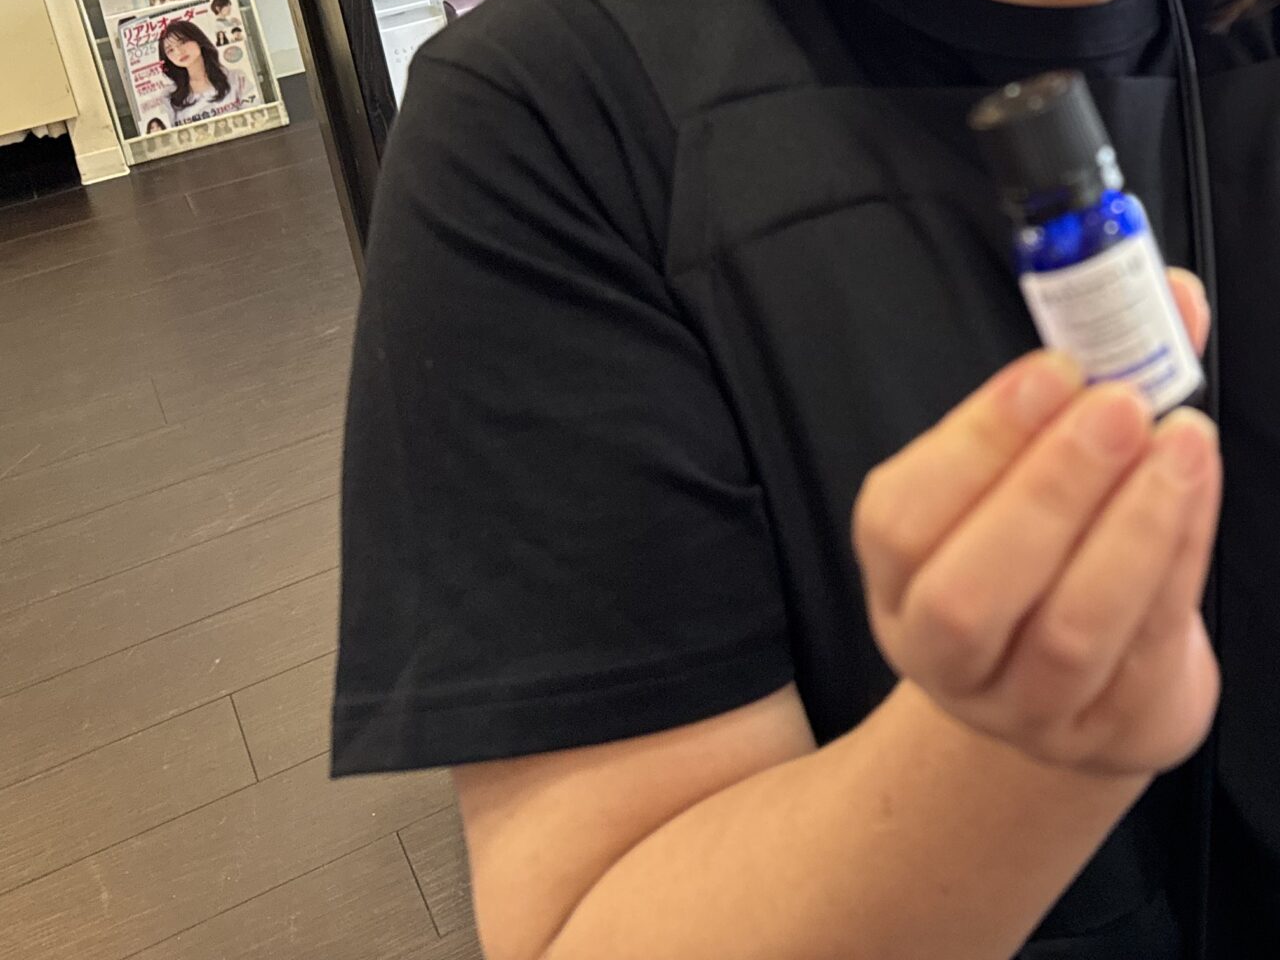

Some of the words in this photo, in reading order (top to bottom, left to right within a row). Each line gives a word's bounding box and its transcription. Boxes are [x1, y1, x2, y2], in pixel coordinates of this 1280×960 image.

[123, 9, 209, 39] リアルオーダー
